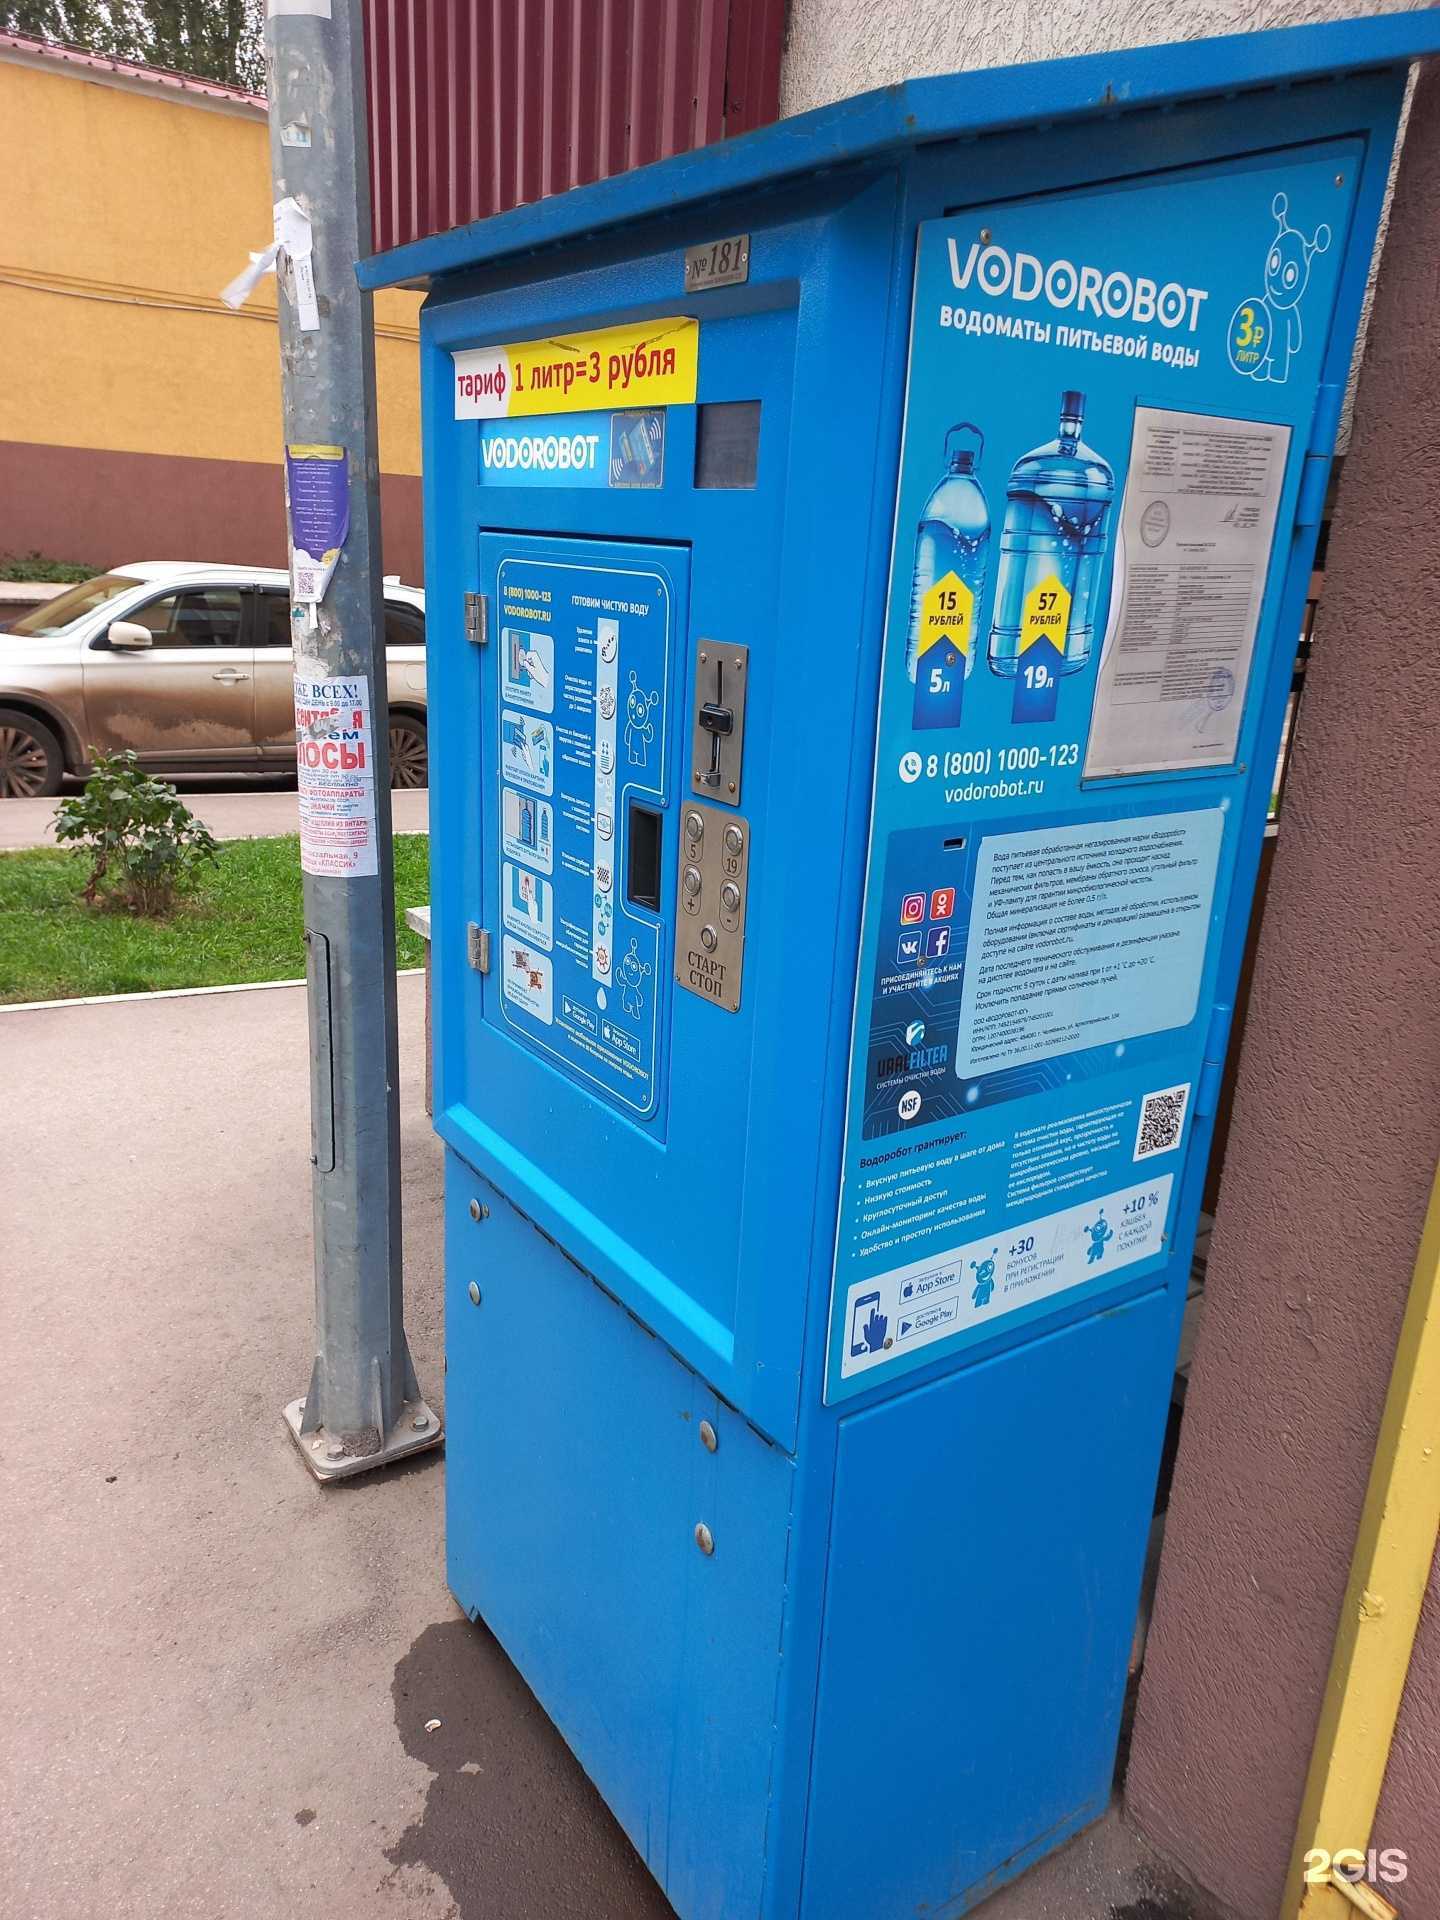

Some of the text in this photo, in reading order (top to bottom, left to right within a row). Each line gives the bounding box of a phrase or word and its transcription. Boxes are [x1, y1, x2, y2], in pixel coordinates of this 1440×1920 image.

[947, 237, 1208, 333] VODOROBOT
[940, 305, 1200, 369] ВОДОМАТЫ ПИТЬЕВОЙ ВОДЫ
[1236, 348, 1260, 364] ЛИТР
[458, 363, 506, 403] тариф
[609, 342, 675, 390] рубля
[481, 434, 599, 471] VODOROBOT
[509, 587, 524, 601] (800)
[938, 591, 957, 611] 15
[1038, 592, 1057, 611] 57
[504, 604, 552, 622] VODOROBOT.RU
[571, 595, 649, 617] ГОТОВИМ ЧИСТУЮ ВОДУ
[928, 613, 963, 625] РУБЛЕЙ
[1029, 612, 1062, 625] РУБЛЕЙ
[312, 684, 358, 699] ВСЕХ!
[926, 743, 1079, 778] 8 (800) 1000-123
[945, 779, 1044, 803] vodorobot.ru
[691, 844, 696, 858] 5
[994, 853, 1009, 862] Вода
[1011, 849, 1040, 859] питьевая
[726, 858, 738, 874] 19
[992, 863, 1024, 873] поступает
[990, 876, 1011, 885] Перед
[986, 910, 1008, 920] Общая
[688, 951, 726, 981] СТАРТ
[880, 968, 942, 985] ПРИСОЕДИНЯЙТЕСЬ
[948, 963, 962, 971] НАМ
[690, 971, 722, 998] СТОП
[888, 979, 927, 993] УЧАСТВУЙТЕ
[934, 973, 959, 984] АКЦИЯХ
[977, 990, 991, 1000] Срок
[876, 1066, 946, 1090] СИСТЕМЫ ОЧИСТКИ ВОДЫ
[901, 1096, 919, 1114] NSF
[860, 1131, 967, 1168] Водоробот грантирует:
[866, 1173, 898, 1188] Вкусную
[900, 1163, 934, 1179] питьевую
[936, 1157, 953, 1169] воду
[986, 1141, 1006, 1155] дома
[864, 1178, 933, 1204] Низкую стоимость
[862, 1189, 948, 1223] Круглосуточный доступ
[1122, 1191, 1160, 1214] +10 %
[859, 1239, 893, 1257] Удобство
[1008, 1236, 1034, 1256] +30
[1005, 1253, 1064, 1281] ПРИ РЕГИСТРАЦИИ
[1006, 1252, 1037, 1270] БОНУСОВ
[916, 1280, 934, 1294] App
[935, 1274, 955, 1287] Store
[1004, 1268, 1055, 1293] В ПРИЛОЖЕНИИ
[915, 1315, 939, 1329] Google
[939, 1309, 953, 1323] Play
